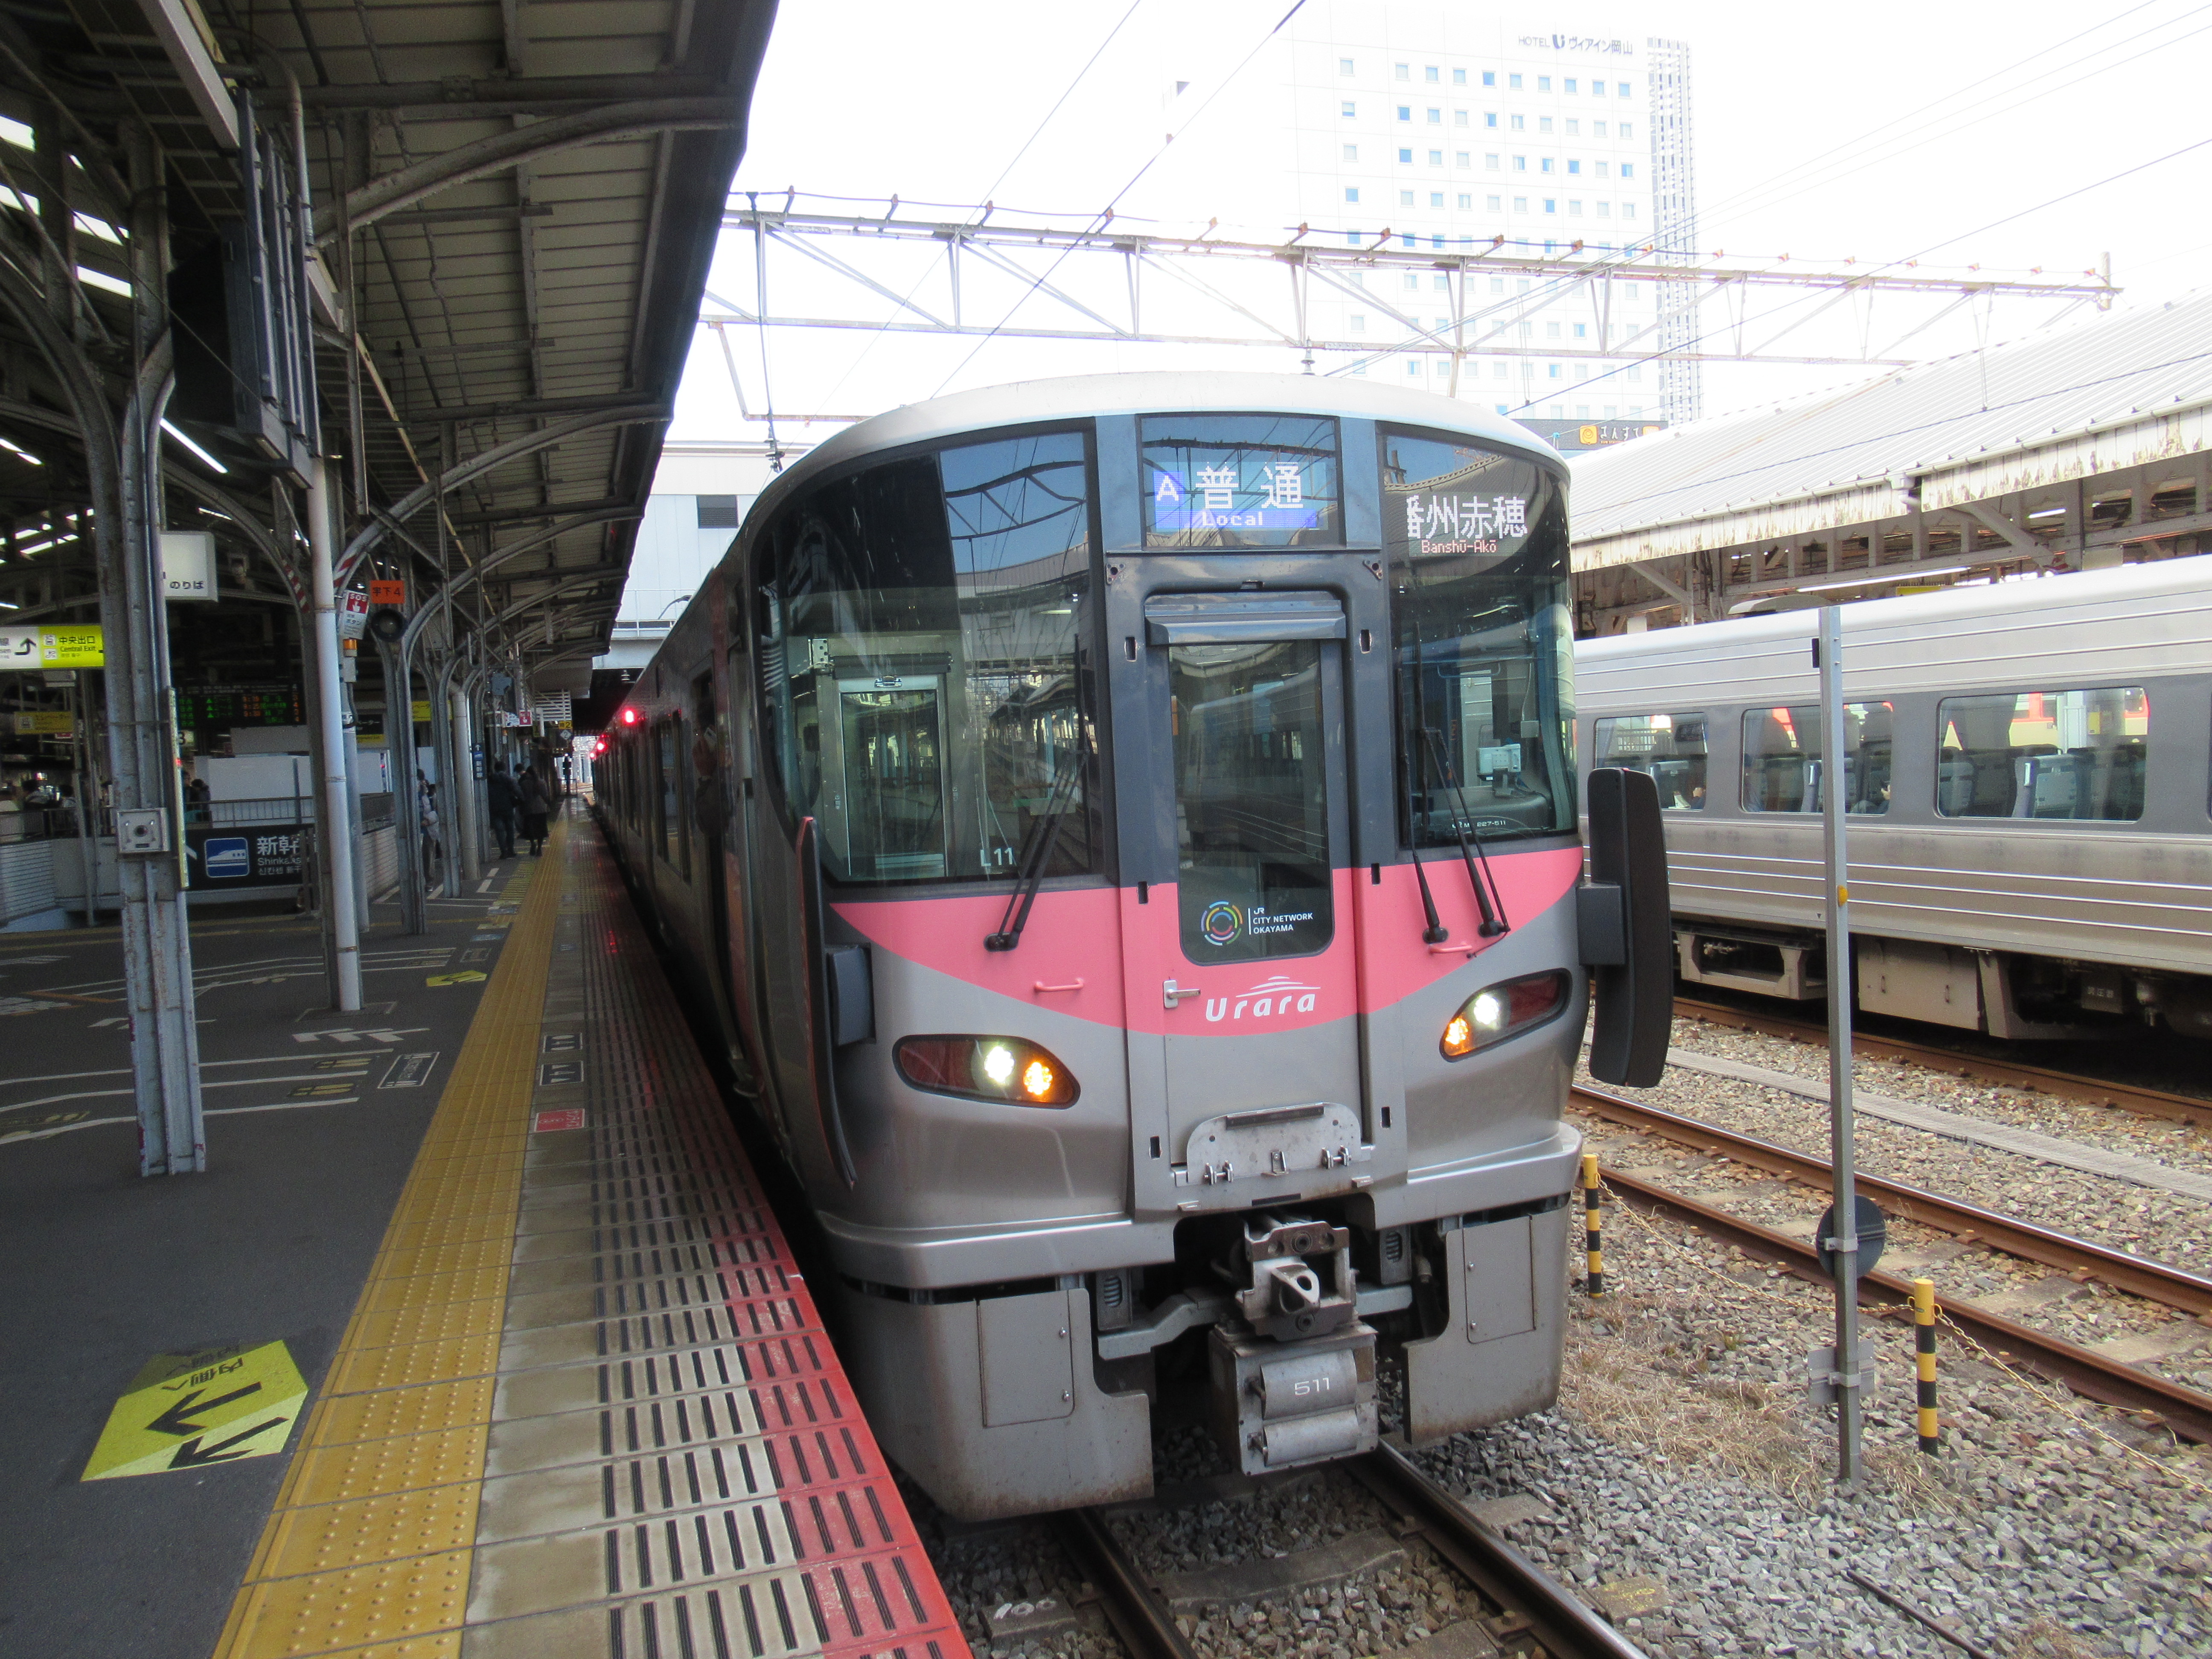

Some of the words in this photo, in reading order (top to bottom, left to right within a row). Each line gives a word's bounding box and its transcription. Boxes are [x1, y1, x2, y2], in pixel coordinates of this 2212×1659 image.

[1519, 35, 1550, 47] HOTEL
[1569, 36, 1633, 55] ヴィアイン岡山
[1156, 475, 1179, 501] A
[1196, 462, 1304, 509] 普通
[1202, 512, 1263, 526] Local
[1421, 540, 1497, 553] Banshū-Akō
[170, 581, 204, 589] のりば
[349, 593, 367, 602] SOS
[59, 635, 96, 645] 中央出口
[257, 836, 300, 855] 新幹
[1253, 916, 1271, 925] CITY
[1273, 912, 1313, 923] NETWORK
[1253, 924, 1294, 934] OKAYAMA
[1205, 993, 1316, 1022] Urara
[1294, 1377, 1330, 1396] 511
